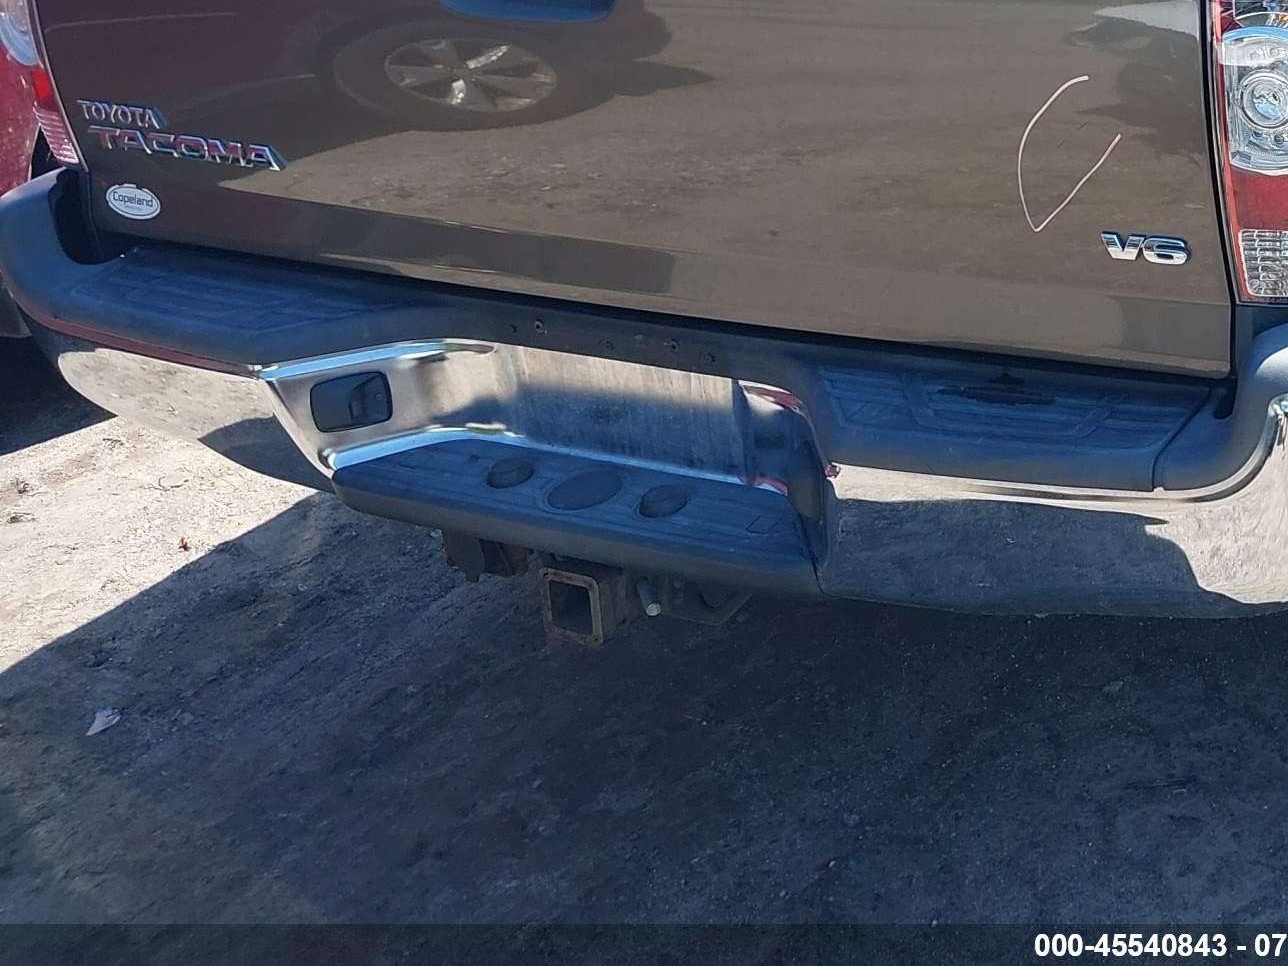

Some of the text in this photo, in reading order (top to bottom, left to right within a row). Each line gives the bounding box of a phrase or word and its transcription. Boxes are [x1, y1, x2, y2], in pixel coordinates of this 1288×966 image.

[76, 99, 162, 129] TOYOTA
[88, 125, 281, 171] TACOMA
[113, 191, 154, 208] Copeland
[1101, 232, 1188, 265] V6
